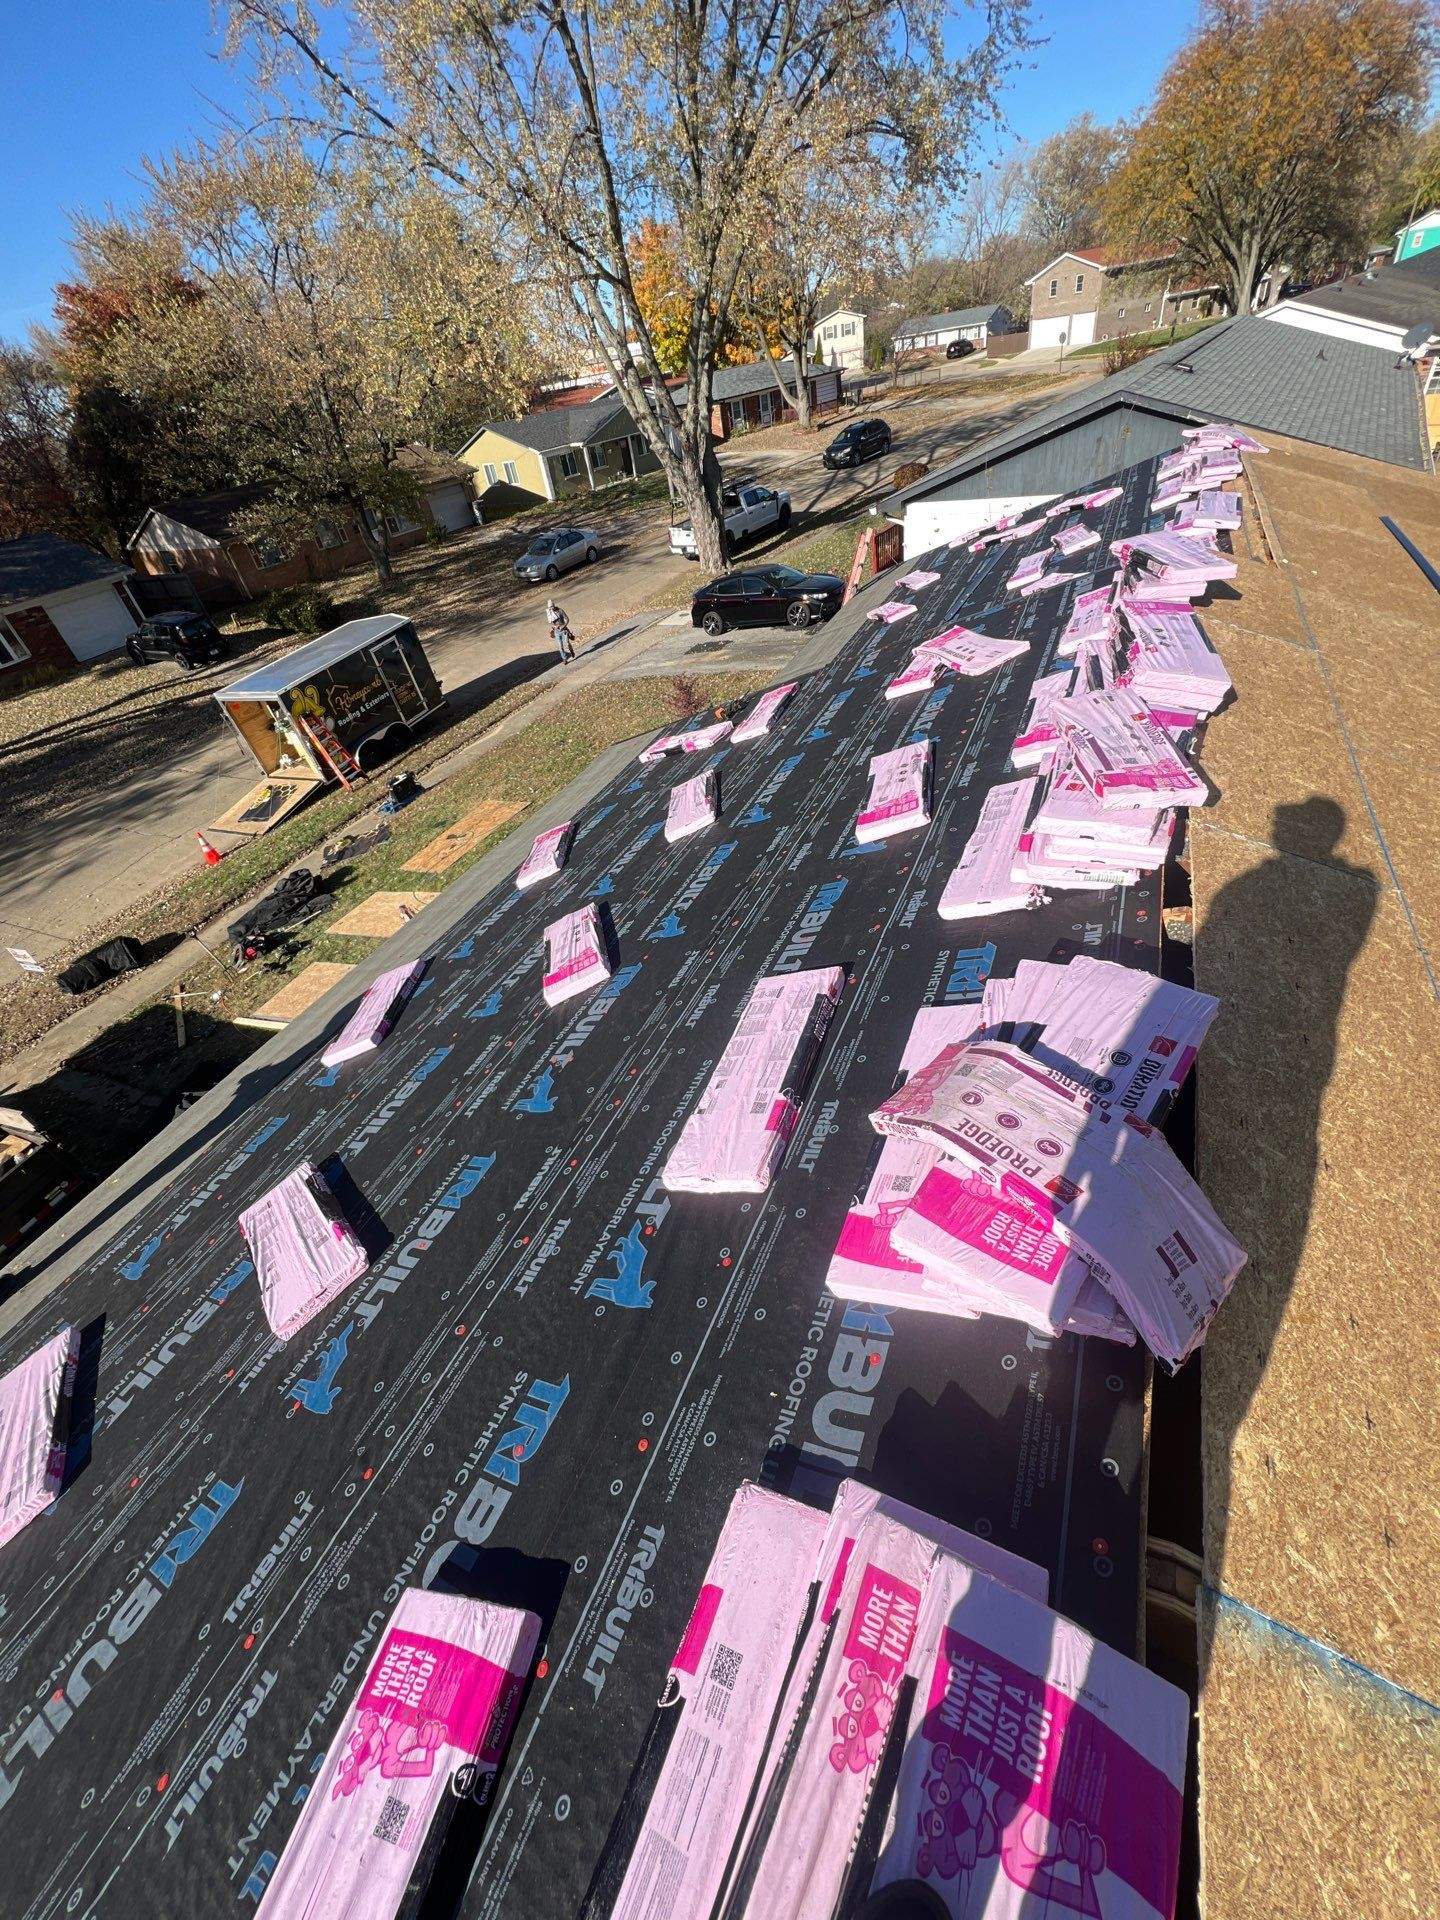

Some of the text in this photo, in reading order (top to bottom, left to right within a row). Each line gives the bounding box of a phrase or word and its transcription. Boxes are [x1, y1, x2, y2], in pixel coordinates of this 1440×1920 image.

[773, 875, 848, 984] TRIBUILT
[549, 962, 642, 1072] TRIBUILT
[346, 1044, 455, 1157] TRIBUILT
[673, 1060, 712, 1117] SYNTHETIC
[639, 1120, 678, 1174] ROOFING
[798, 1100, 839, 1176] TRIBUILT
[952, 1117, 1045, 1178] PROEDGE
[348, 1151, 496, 1336] TRIBUILT
[514, 1218, 571, 1300] TRIBUILT
[570, 1178, 644, 1294] UNDERLAYMENT
[981, 1211, 1006, 1250] ROOF
[1007, 1218, 1027, 1245] JUST
[1011, 1225, 1043, 1265] THAN
[1031, 1232, 1060, 1271] MORE
[278, 1155, 469, 1394] SYNTHETIC ROOFING UNDERLAYMENT
[689, 1410, 700, 1426] TYPE
[696, 1388, 709, 1409] D4869
[705, 1395, 713, 1405] OR
[709, 1373, 722, 1395] MEETS
[769, 1346, 818, 1448] ROOFING
[455, 1371, 528, 1485] SYNTHETIC
[676, 1437, 689, 1458] ASTM
[683, 1435, 697, 1458] ASTM
[692, 1405, 709, 1435] EXCEEDS
[668, 1476, 680, 1496] TYPE
[676, 1457, 688, 1476] D226
[126, 1471, 216, 1583] SYNTHETIC
[222, 1490, 314, 1623] TRIBUILT
[384, 1490, 457, 1603] ROOFING
[36, 1588, 123, 1698] ROOFING
[583, 1524, 665, 1701] TRIBUILT
[856, 1584, 892, 1650] MORE
[878, 1595, 917, 1662] THAN
[369, 1641, 403, 1698] MORE
[381, 1643, 416, 1700] THAN
[397, 1664, 420, 1704] JUST
[404, 1650, 437, 1708] ROOF
[941, 1650, 976, 1729] MORE
[963, 1665, 1003, 1746] THAN
[993, 1687, 1026, 1767] JUST A
[1018, 1697, 1053, 1785] ROOF
[162, 1671, 278, 1861] TRIBUILT
[228, 1611, 385, 1880] UNDERLAYMENT
[476, 1806, 515, 1886] OVERLAP LINE
